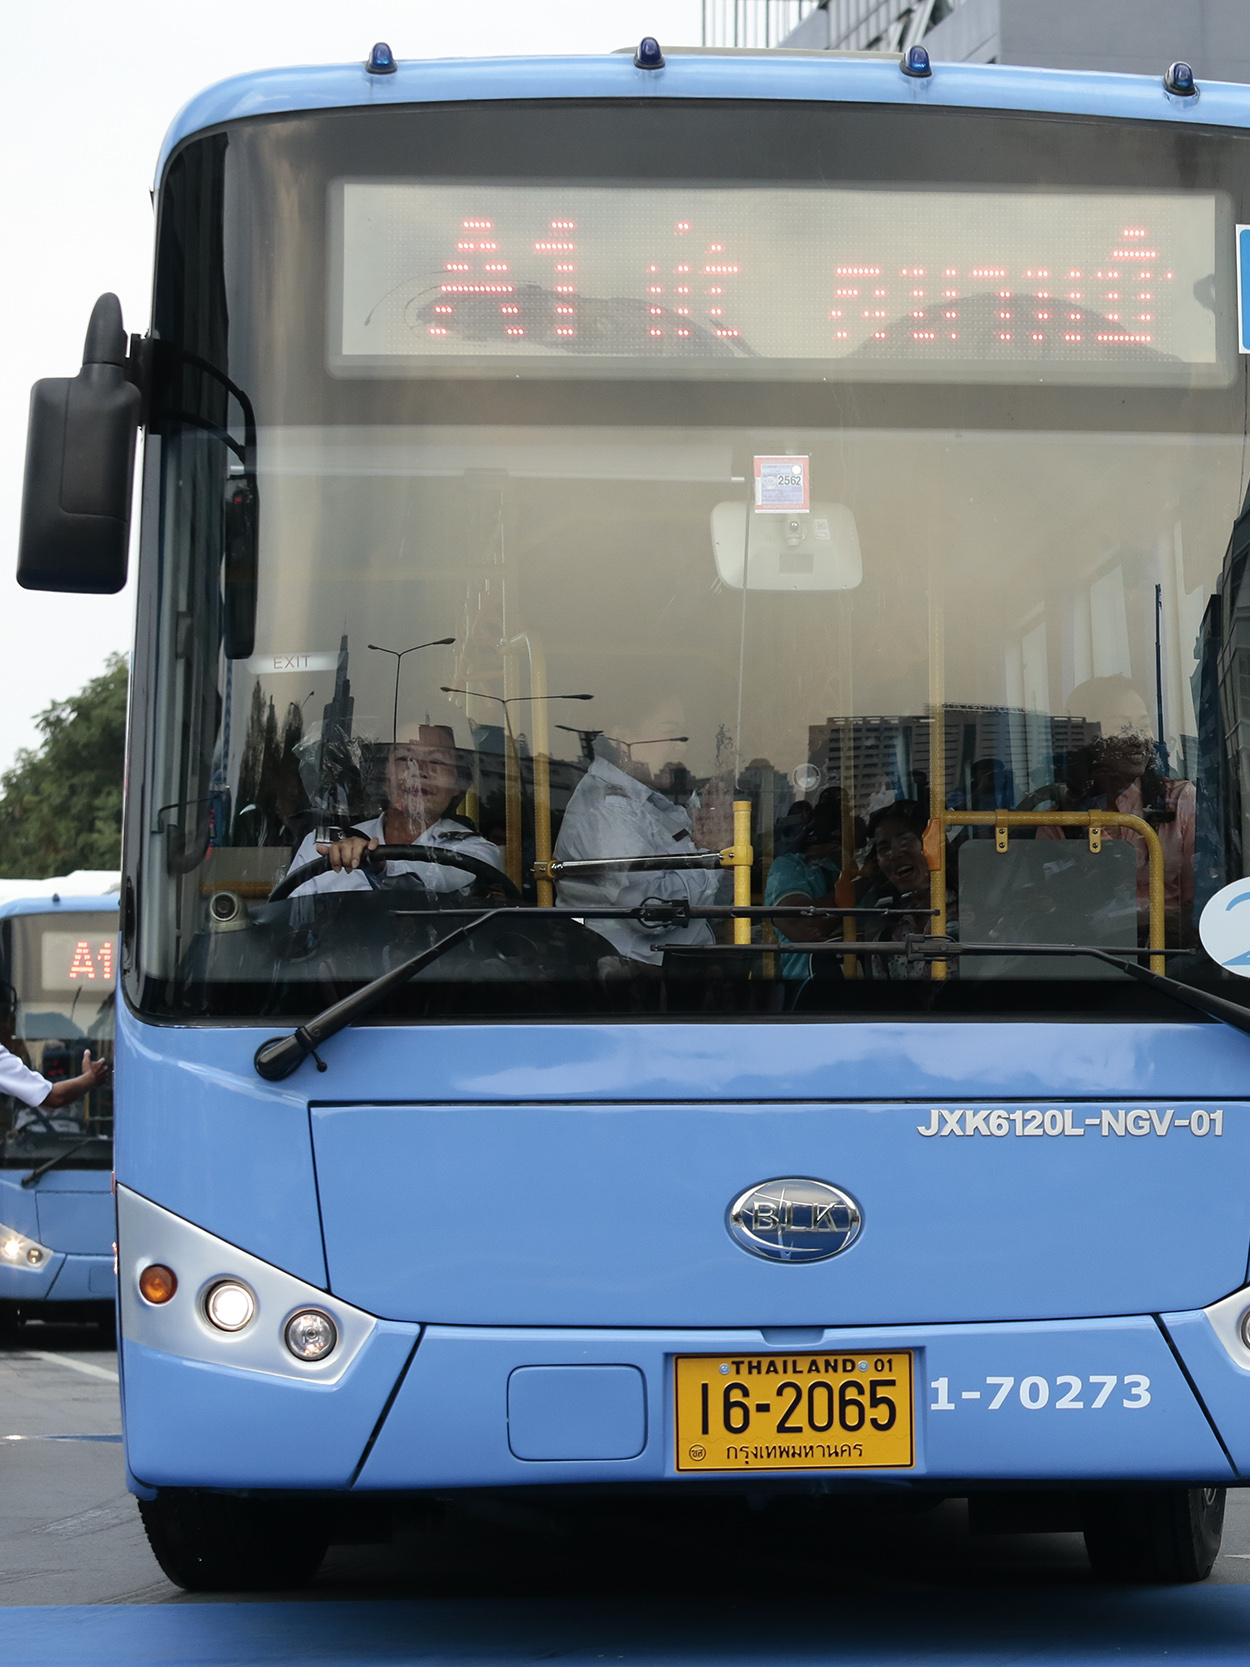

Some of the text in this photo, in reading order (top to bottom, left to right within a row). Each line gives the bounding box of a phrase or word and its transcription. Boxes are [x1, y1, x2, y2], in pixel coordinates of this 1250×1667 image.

[428, 217, 577, 339] A1
[778, 475, 801, 486] 2562
[273, 655, 311, 669] EXIT
[69, 942, 112, 978] A1
[916, 1108, 1225, 1138] JXK6120L-NGV-01
[731, 1357, 894, 1375] THAILAND 01
[700, 1378, 898, 1436] 16-2065
[929, 1374, 1153, 1410] 1-70273
[726, 1442, 864, 1465] กรุงเทพมหานคร
